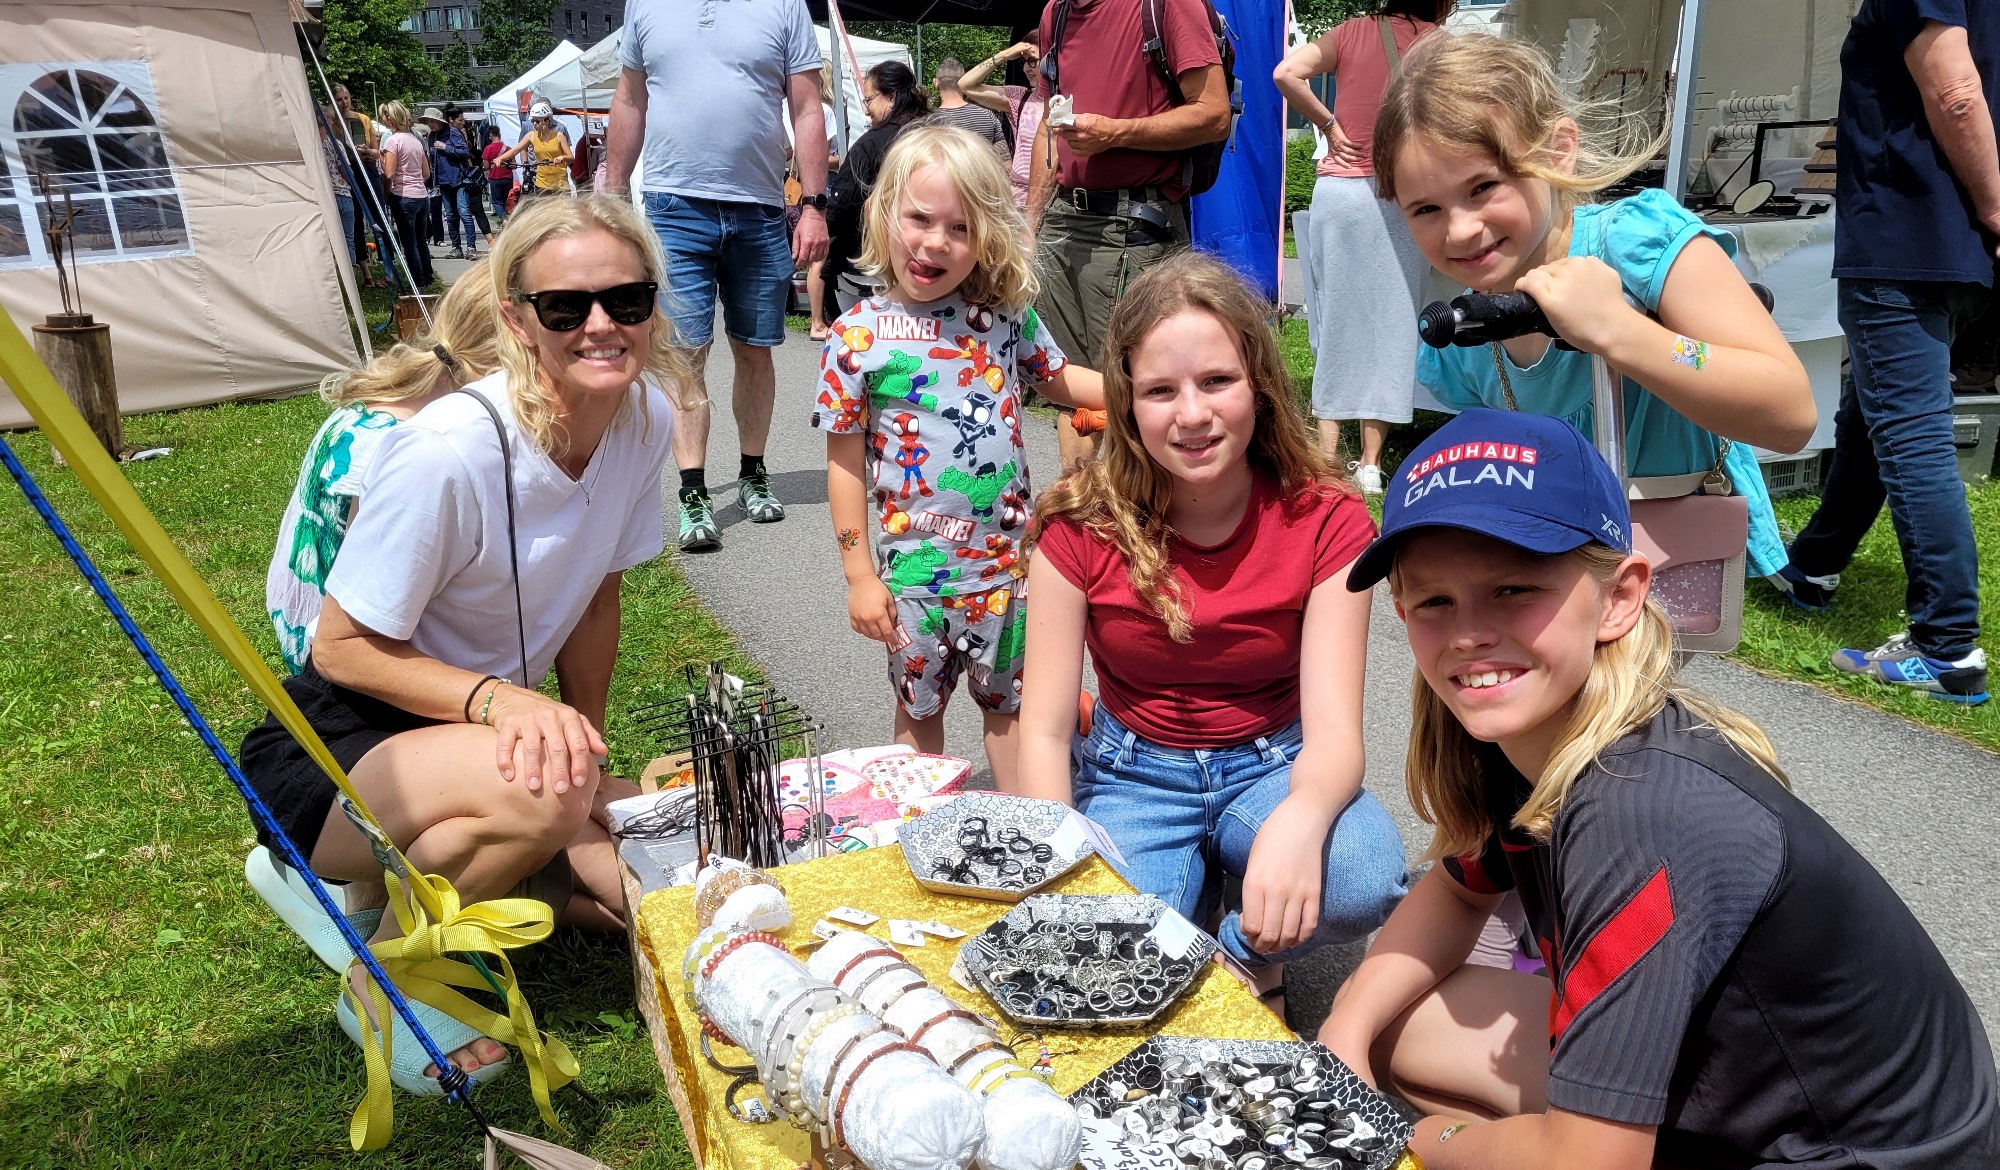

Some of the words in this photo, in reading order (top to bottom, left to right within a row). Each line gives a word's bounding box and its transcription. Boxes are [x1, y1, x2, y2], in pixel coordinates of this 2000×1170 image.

[878, 315, 938, 340] MARVEL
[1420, 444, 1535, 474] BAUHAUS
[1403, 463, 1535, 508] GALAN
[915, 511, 974, 542] MARVEL
